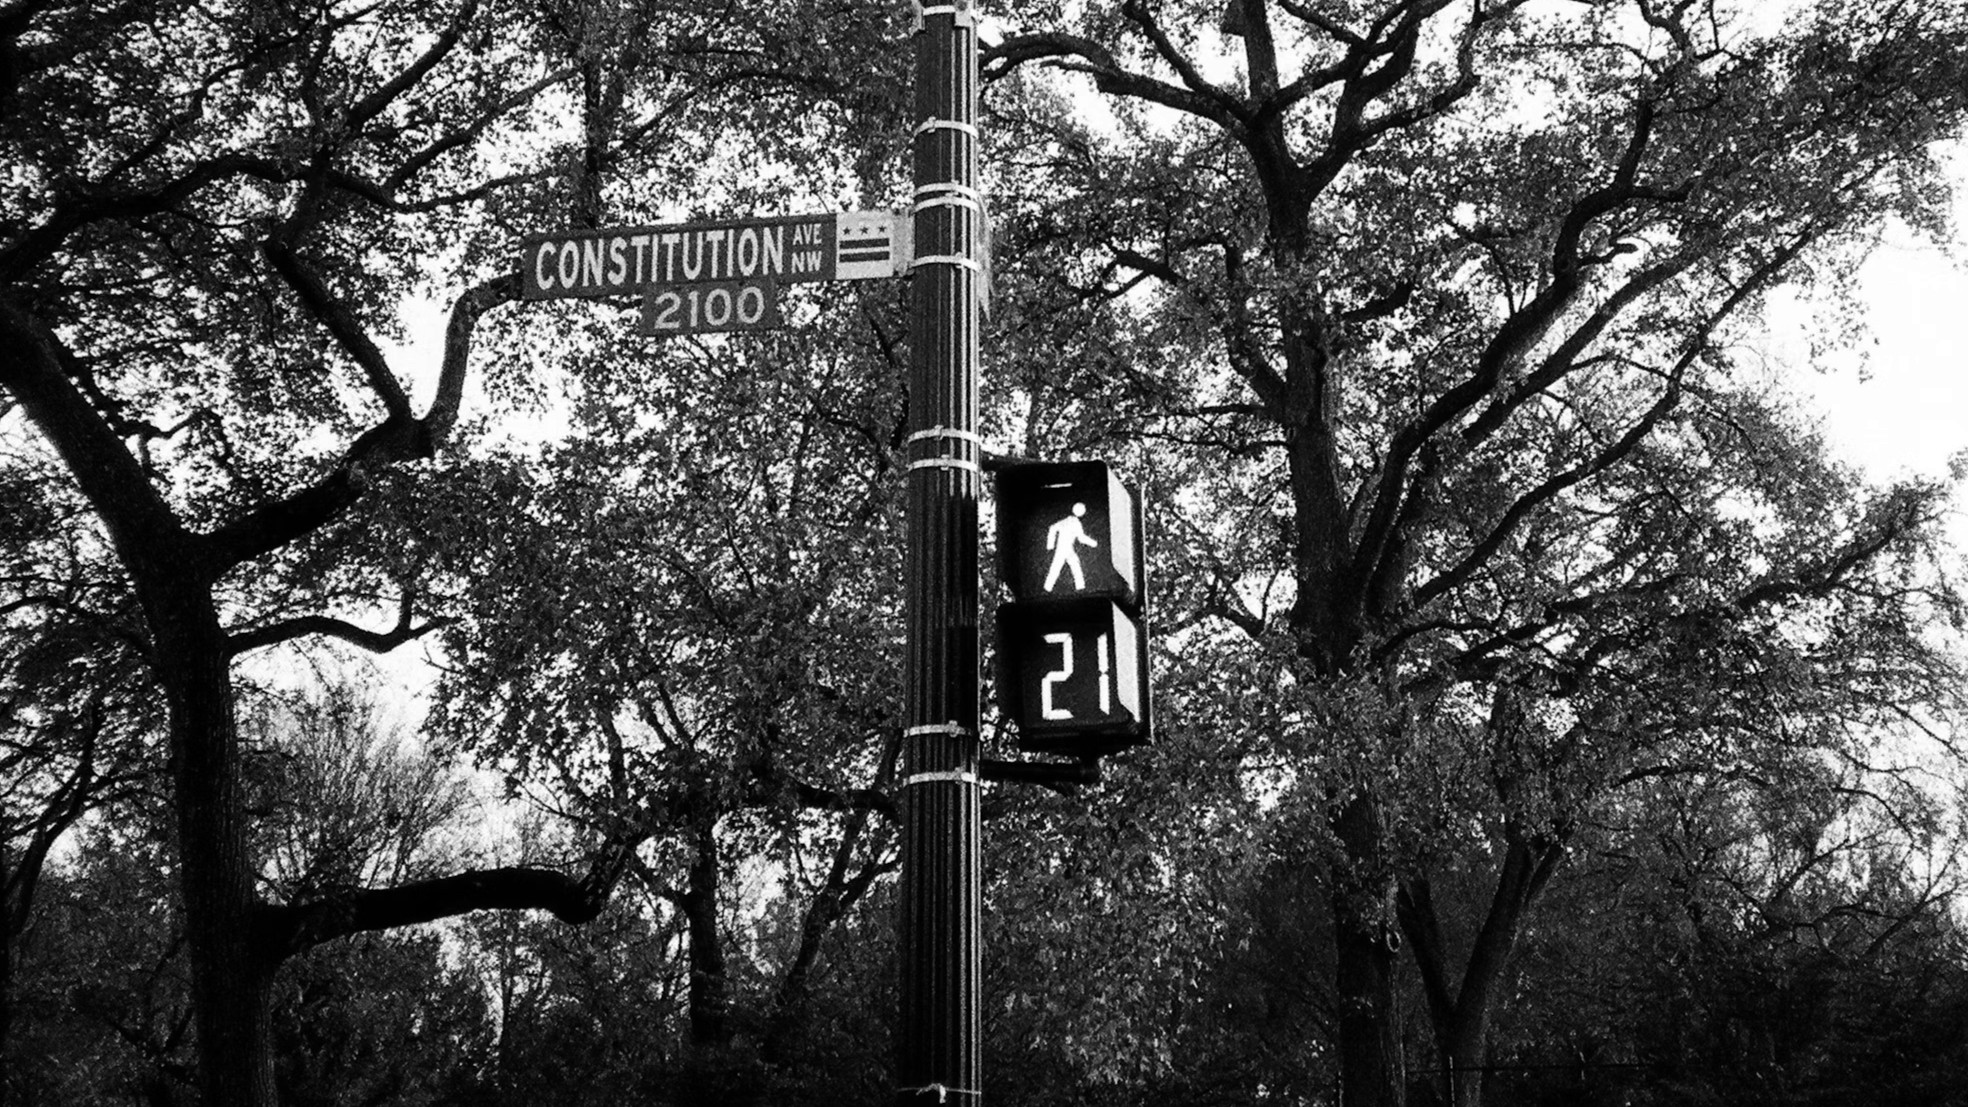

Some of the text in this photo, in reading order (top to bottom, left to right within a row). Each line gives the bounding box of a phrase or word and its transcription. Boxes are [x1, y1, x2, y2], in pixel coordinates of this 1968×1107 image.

[792, 223, 822, 245] AVE
[535, 226, 784, 290] CONSTITUTION
[791, 251, 822, 274] NW
[654, 286, 765, 329] 2100
[1041, 632, 1110, 720] 21
